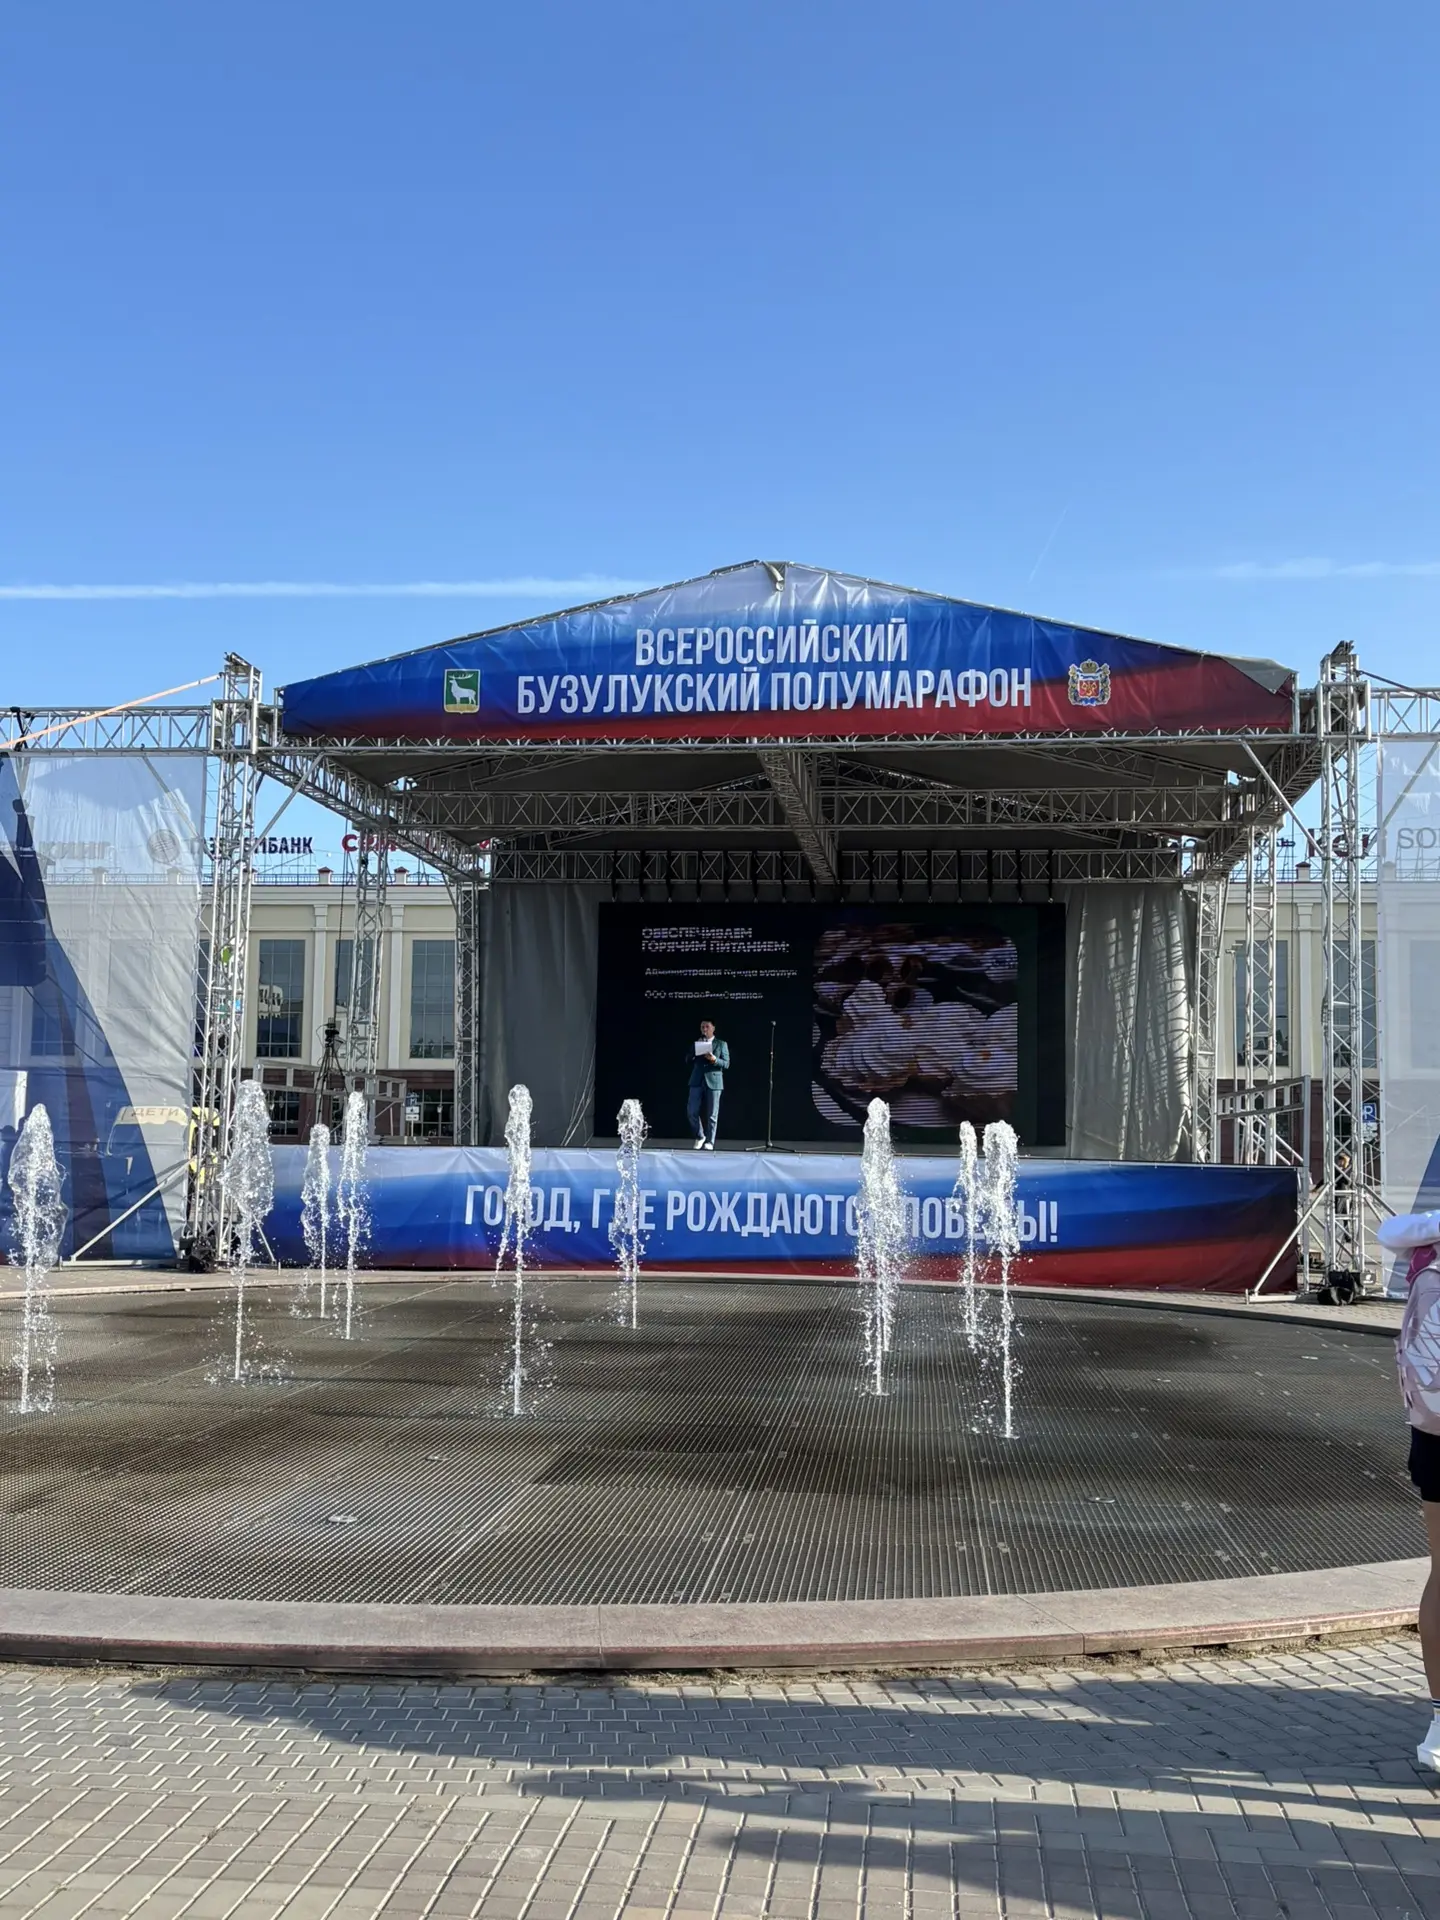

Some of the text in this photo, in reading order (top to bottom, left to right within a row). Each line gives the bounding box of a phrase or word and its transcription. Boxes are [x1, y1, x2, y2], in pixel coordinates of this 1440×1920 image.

[635, 617, 908, 666] ВСЕРОССИЙСКИЙ
[517, 666, 1032, 714] БУЗУЛУКСКИЙ ПОЛУМАРАФОН
[1398, 827, 1440, 849] SO
[642, 926, 753, 939] ОБЕСПЕЧИВАЕМ
[642, 940, 707, 952] ГОРЯЧИМ
[131, 1107, 180, 1118] ДЕТИ
[465, 1185, 581, 1234] ГООД,
[666, 1190, 882, 1238] РОЖДАЮТС
